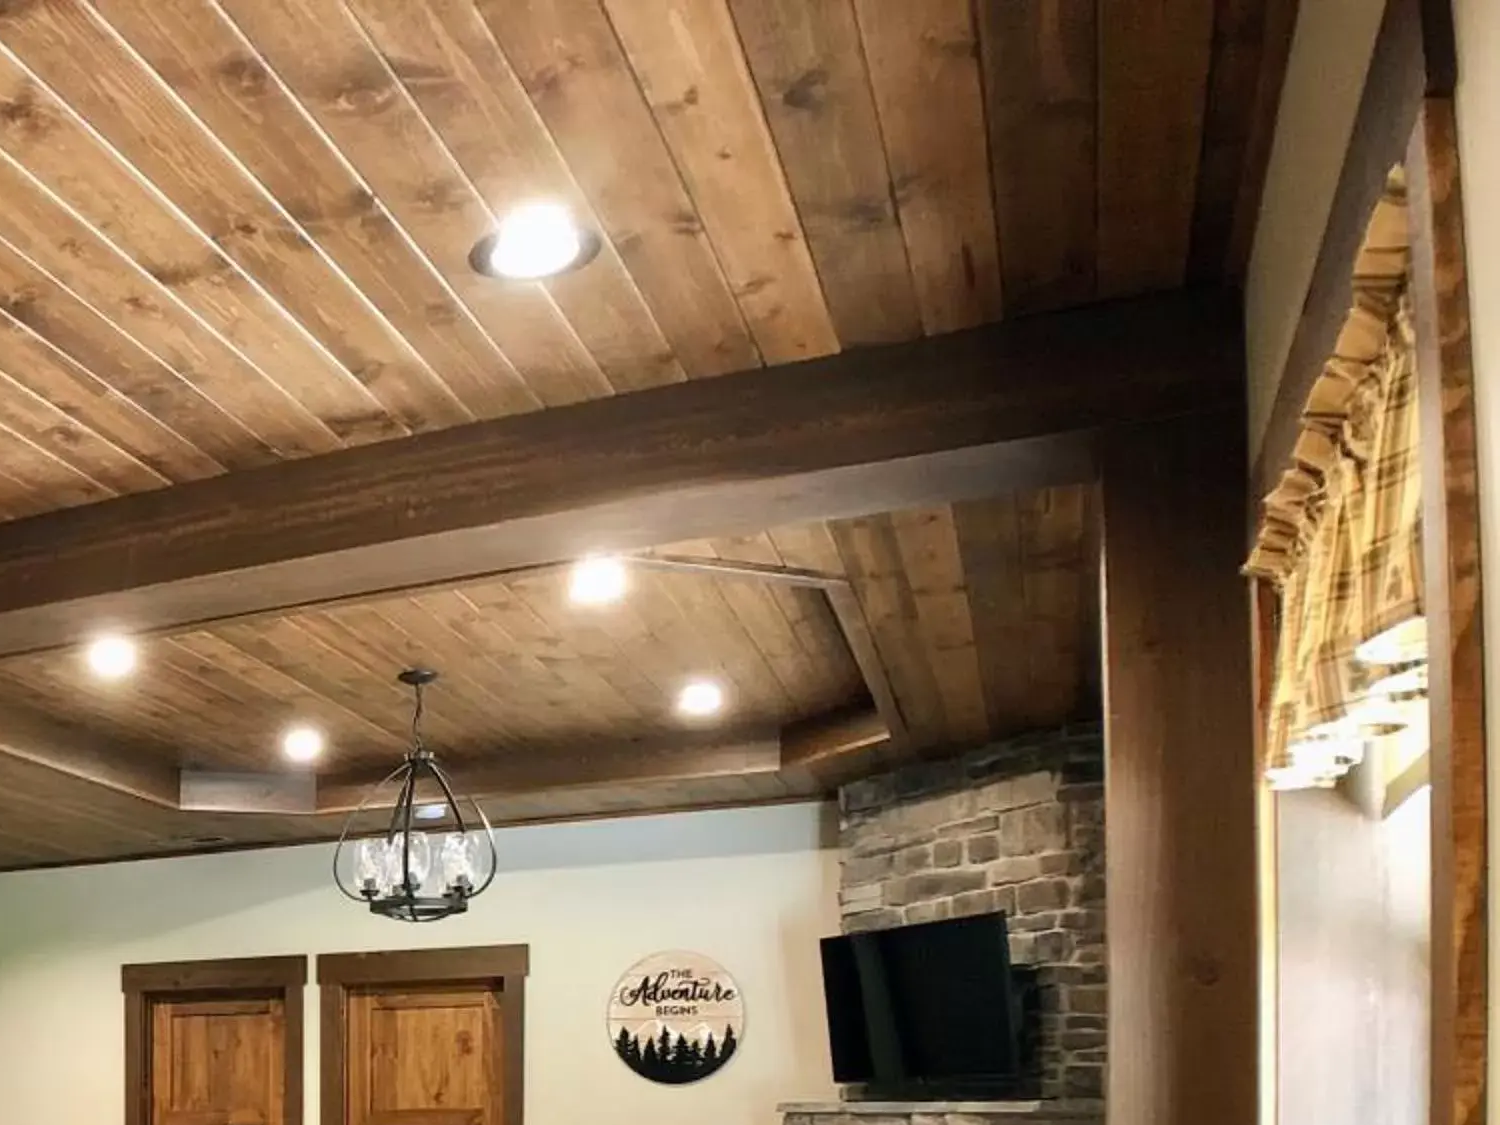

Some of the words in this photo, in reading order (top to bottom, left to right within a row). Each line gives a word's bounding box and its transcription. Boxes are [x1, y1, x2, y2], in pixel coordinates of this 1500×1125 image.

[670, 969, 693, 979] THE
[620, 972, 736, 1007] Adventure
[655, 1005, 698, 1017] BEGINS
